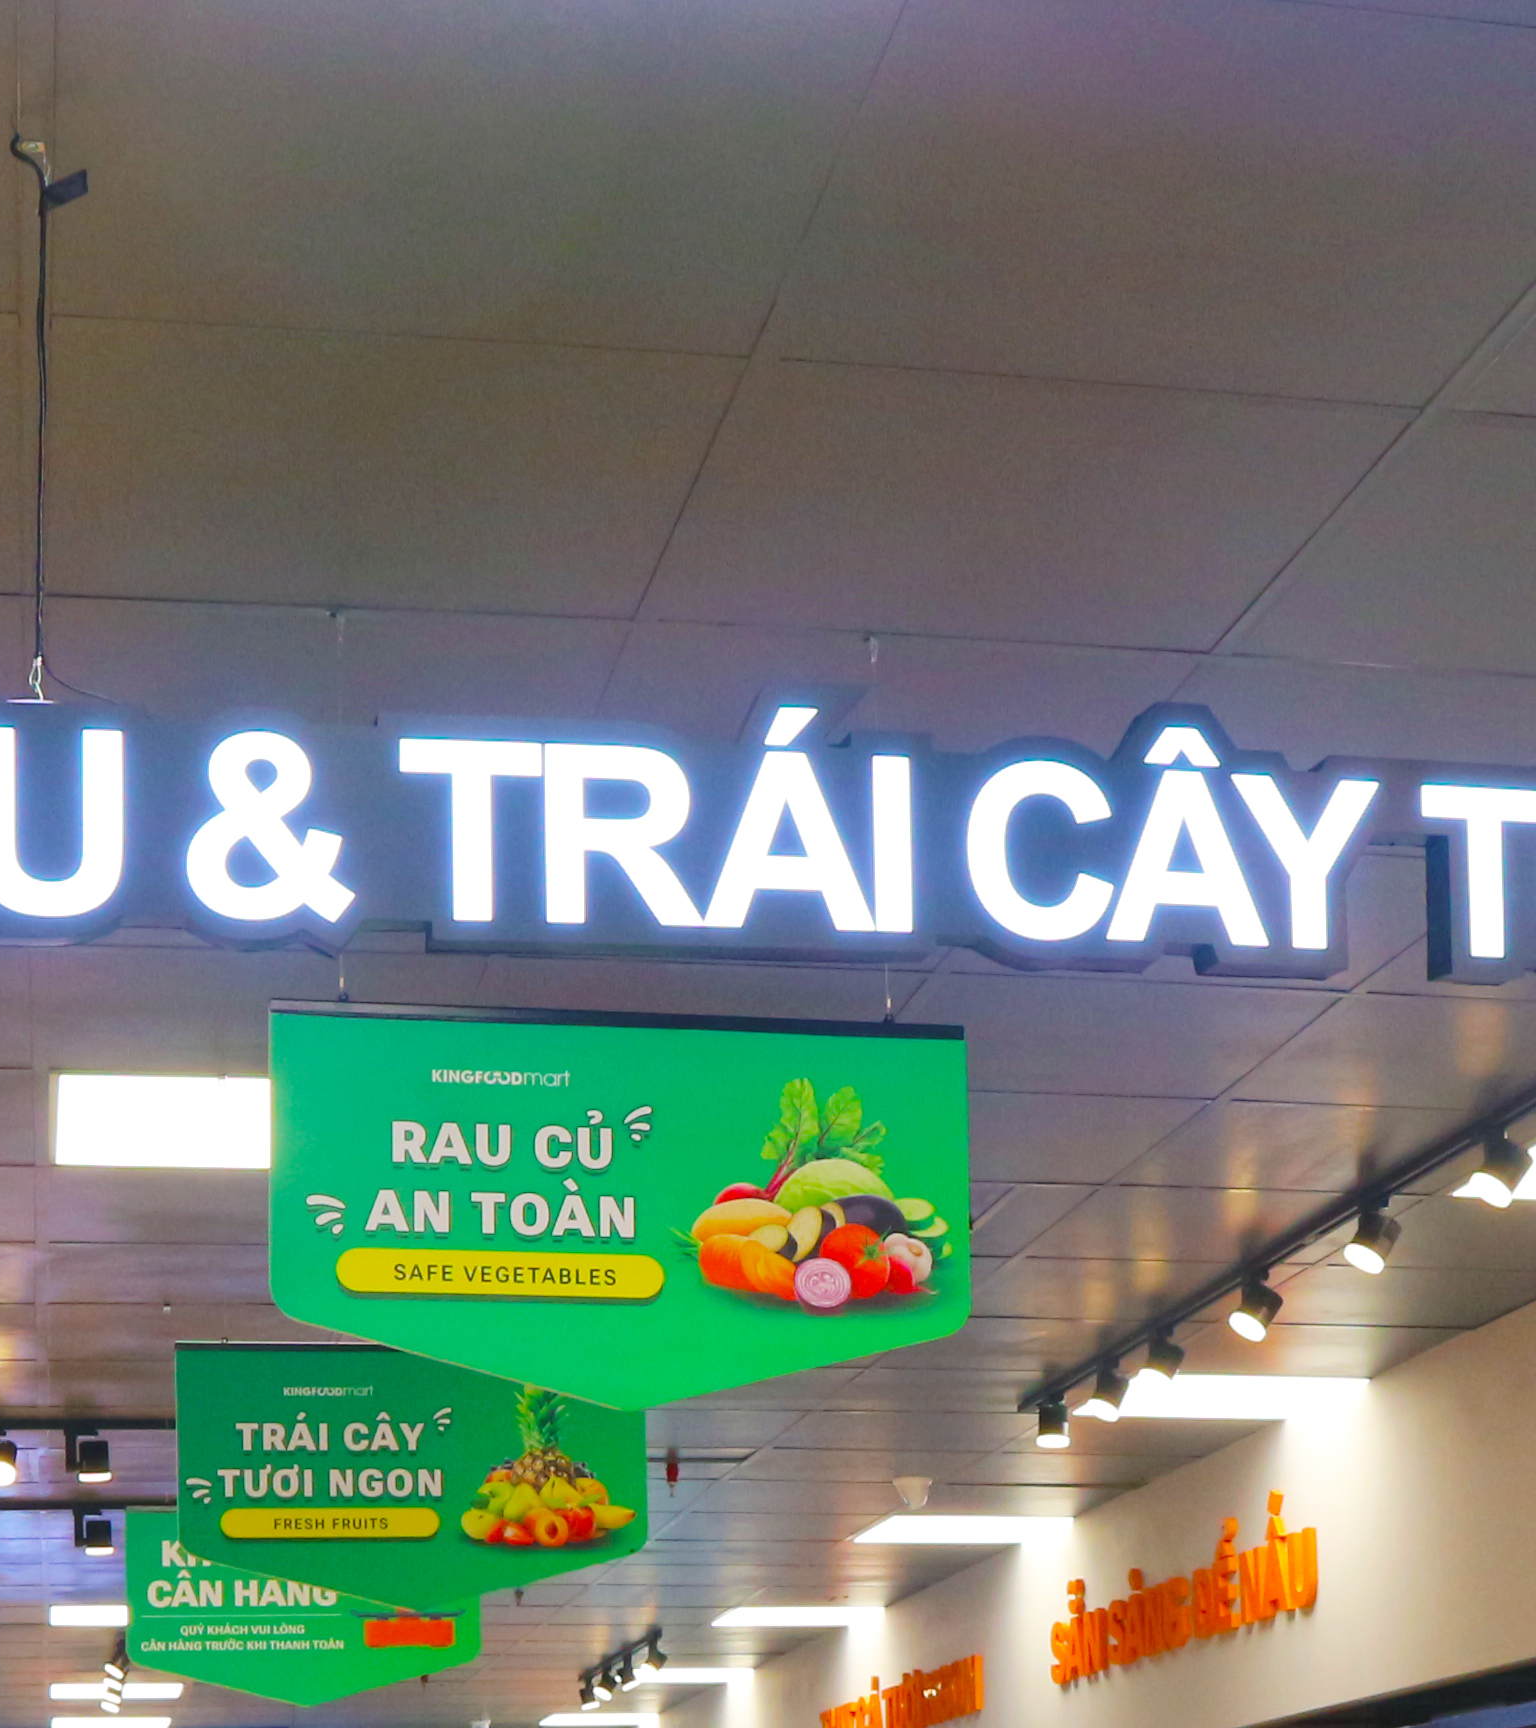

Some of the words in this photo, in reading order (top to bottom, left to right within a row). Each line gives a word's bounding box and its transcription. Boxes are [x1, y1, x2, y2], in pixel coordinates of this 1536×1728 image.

[186, 730, 356, 925] &
[399, 706, 912, 934] TRÁI
[966, 726, 1379, 950] CÂY
[391, 1119, 513, 1168] RAU
[534, 1109, 613, 1171] CỦ
[364, 1188, 451, 1234] AN
[470, 1177, 636, 1239] TOÀN
[393, 1263, 454, 1282] SAFE
[464, 1265, 617, 1287] VEGETABLES
[235, 1411, 329, 1452] TRÁI
[343, 1411, 425, 1452] CÂY
[217, 1464, 314, 1498] TƯƠI
[329, 1468, 444, 1498] NGON
[273, 1517, 326, 1531] FRESH
[332, 1516, 389, 1530] FRUITS
[147, 1569, 224, 1609] CÂN
[207, 1622, 248, 1636] KHÁCH
[250, 1624, 271, 1636] VUI
[246, 1640, 267, 1651] KHI
[269, 1640, 310, 1651] THANH
